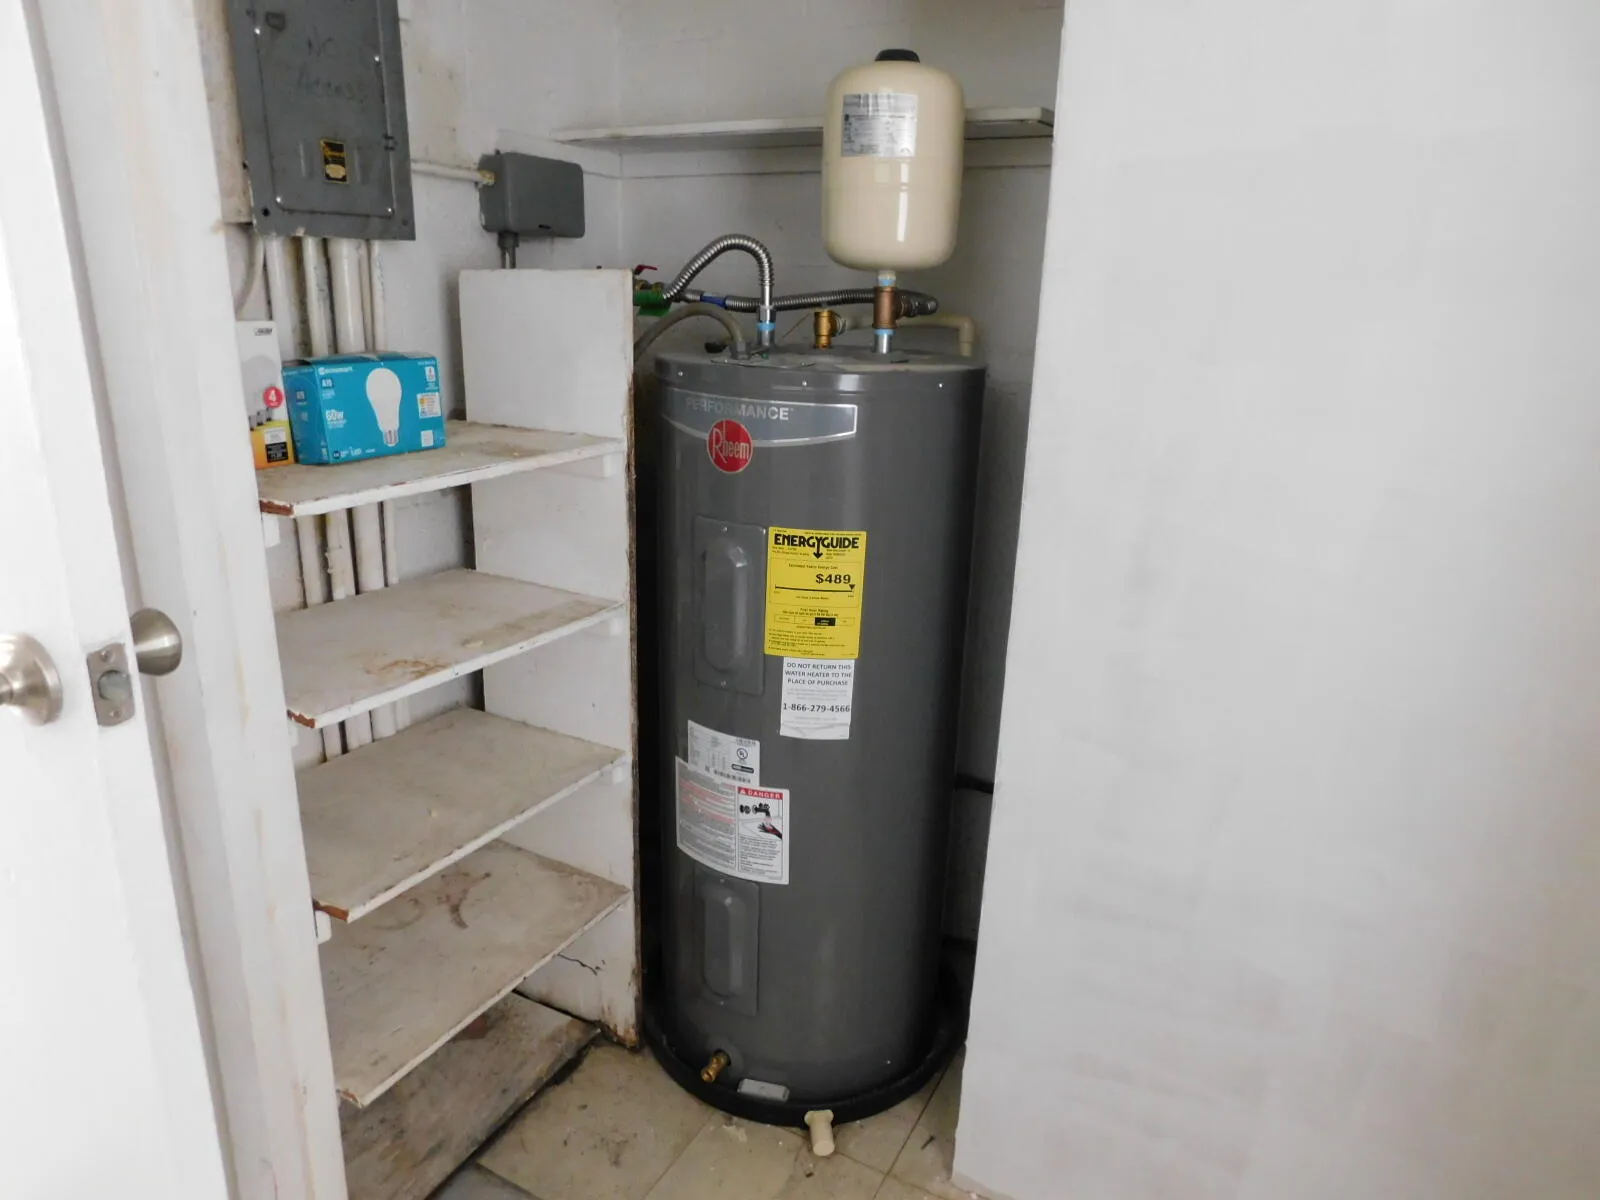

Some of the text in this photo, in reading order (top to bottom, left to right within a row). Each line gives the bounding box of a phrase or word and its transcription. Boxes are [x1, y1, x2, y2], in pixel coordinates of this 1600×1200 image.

[686, 397, 789, 420] PERFORMANCE
[712, 420, 750, 463] Rheem
[815, 573, 851, 584] $489
[783, 703, 850, 712] 1-866-279-4566
[748, 791, 781, 799] DANGER
